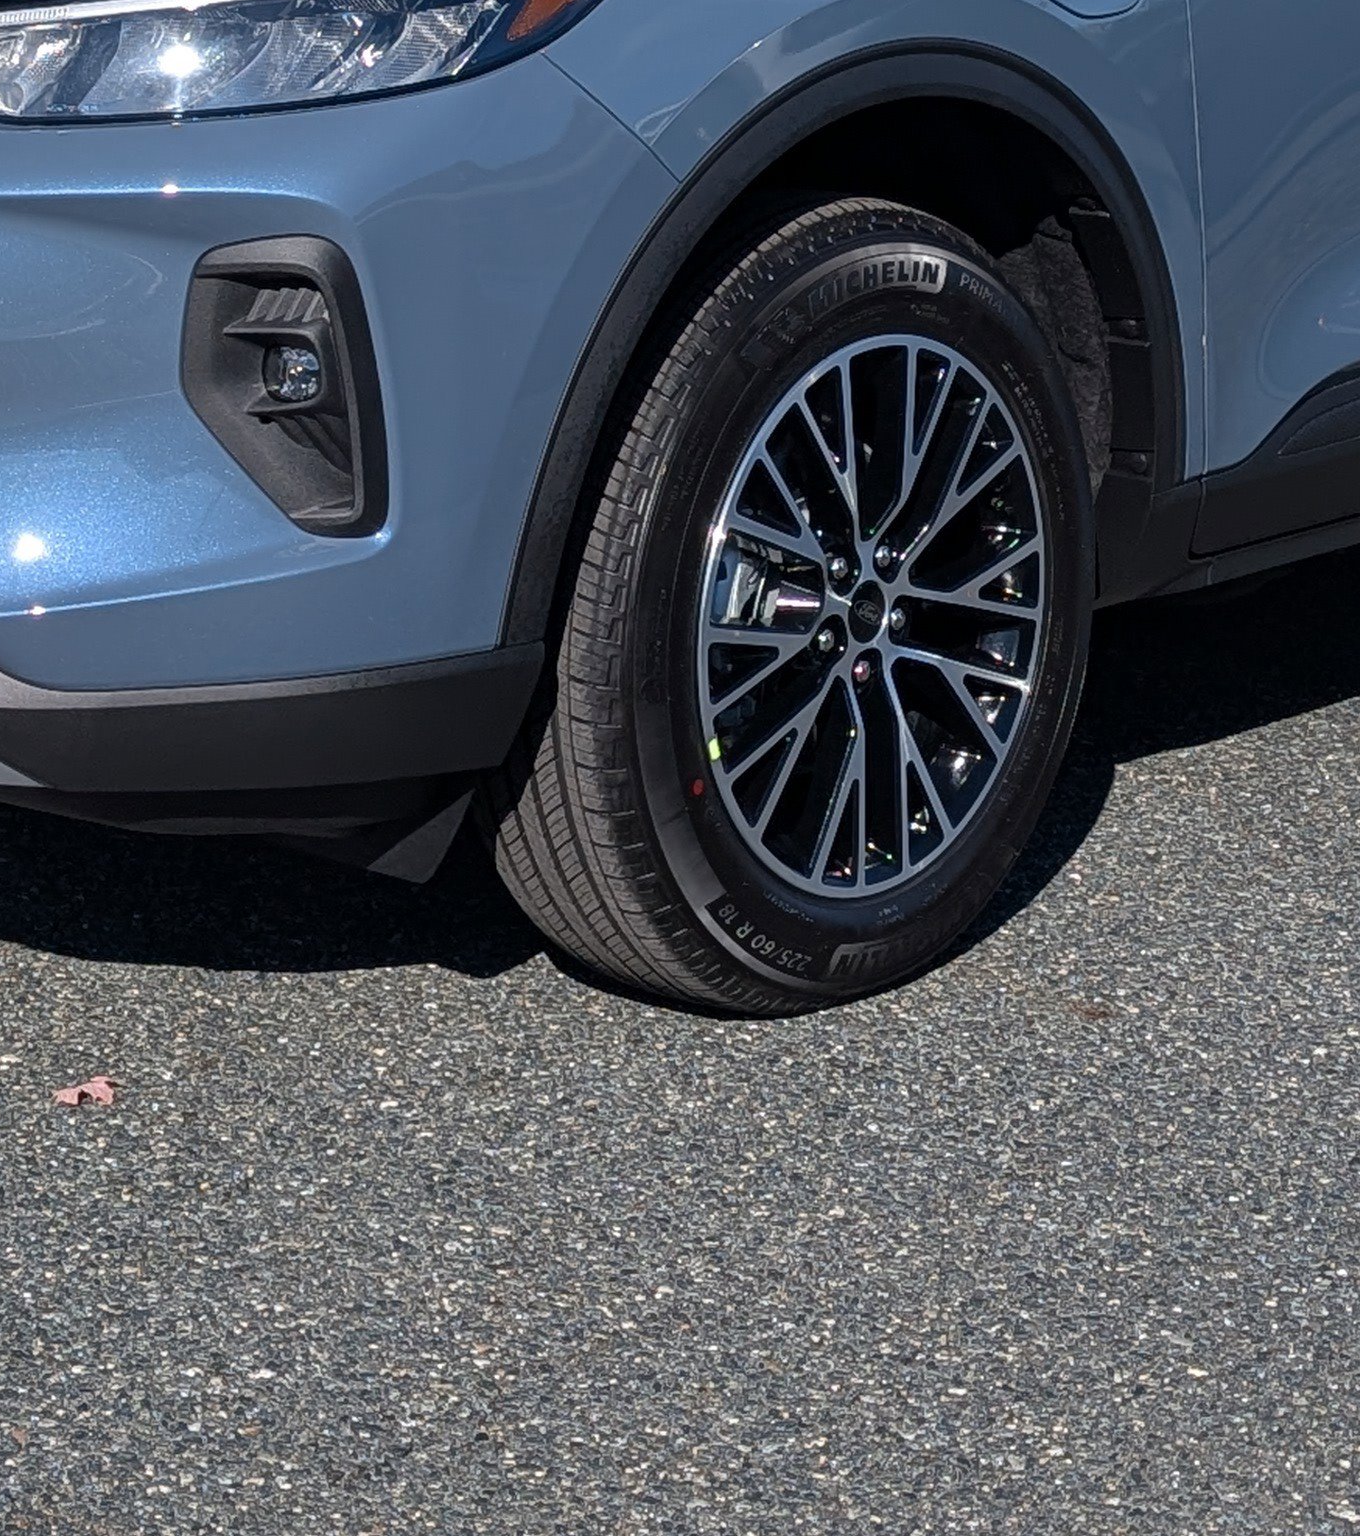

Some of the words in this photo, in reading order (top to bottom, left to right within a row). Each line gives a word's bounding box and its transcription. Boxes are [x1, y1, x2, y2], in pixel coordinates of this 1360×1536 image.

[806, 260, 940, 318] MICHELIN
[718, 903, 739, 925] 18
[735, 920, 755, 939] R
[750, 932, 813, 972] 225/60
